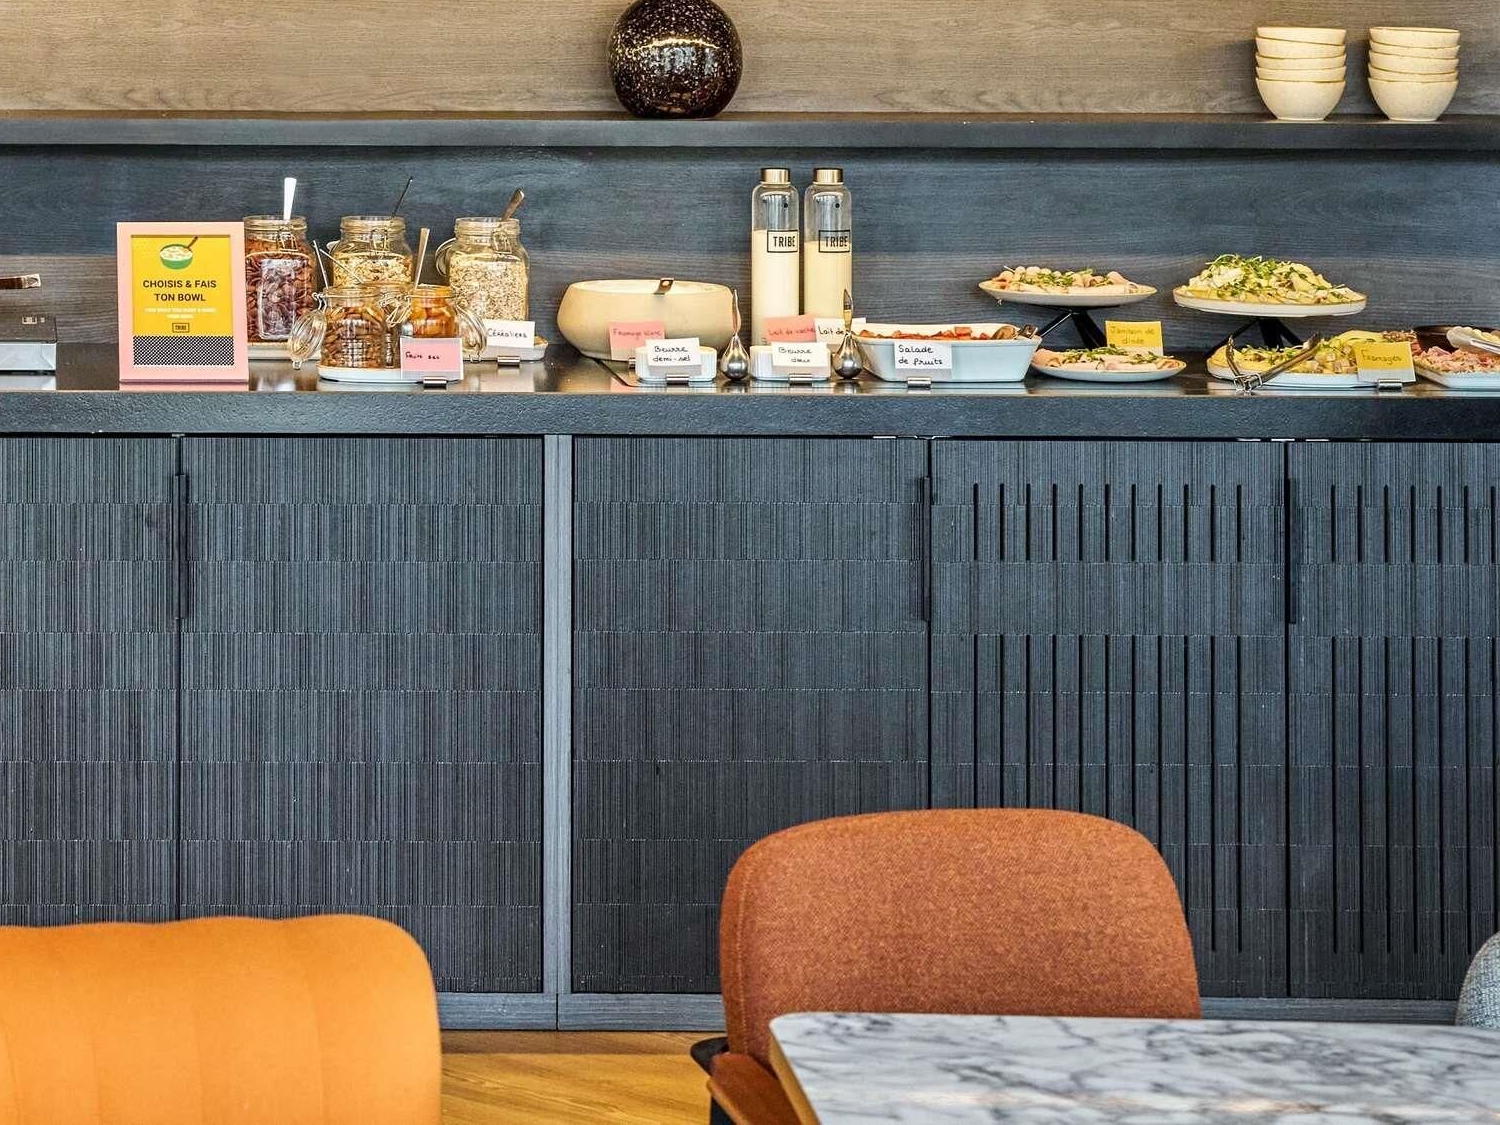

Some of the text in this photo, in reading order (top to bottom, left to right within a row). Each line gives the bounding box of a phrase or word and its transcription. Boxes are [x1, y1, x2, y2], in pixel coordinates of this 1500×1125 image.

[773, 236, 796, 247] TRIBE
[825, 236, 848, 247] TRIBE
[143, 280, 217, 288] CHOISIS & FAIS
[155, 293, 206, 301] TON BOWL
[818, 325, 834, 335] Lait
[898, 345, 934, 353] Salade
[898, 356, 909, 364] de
